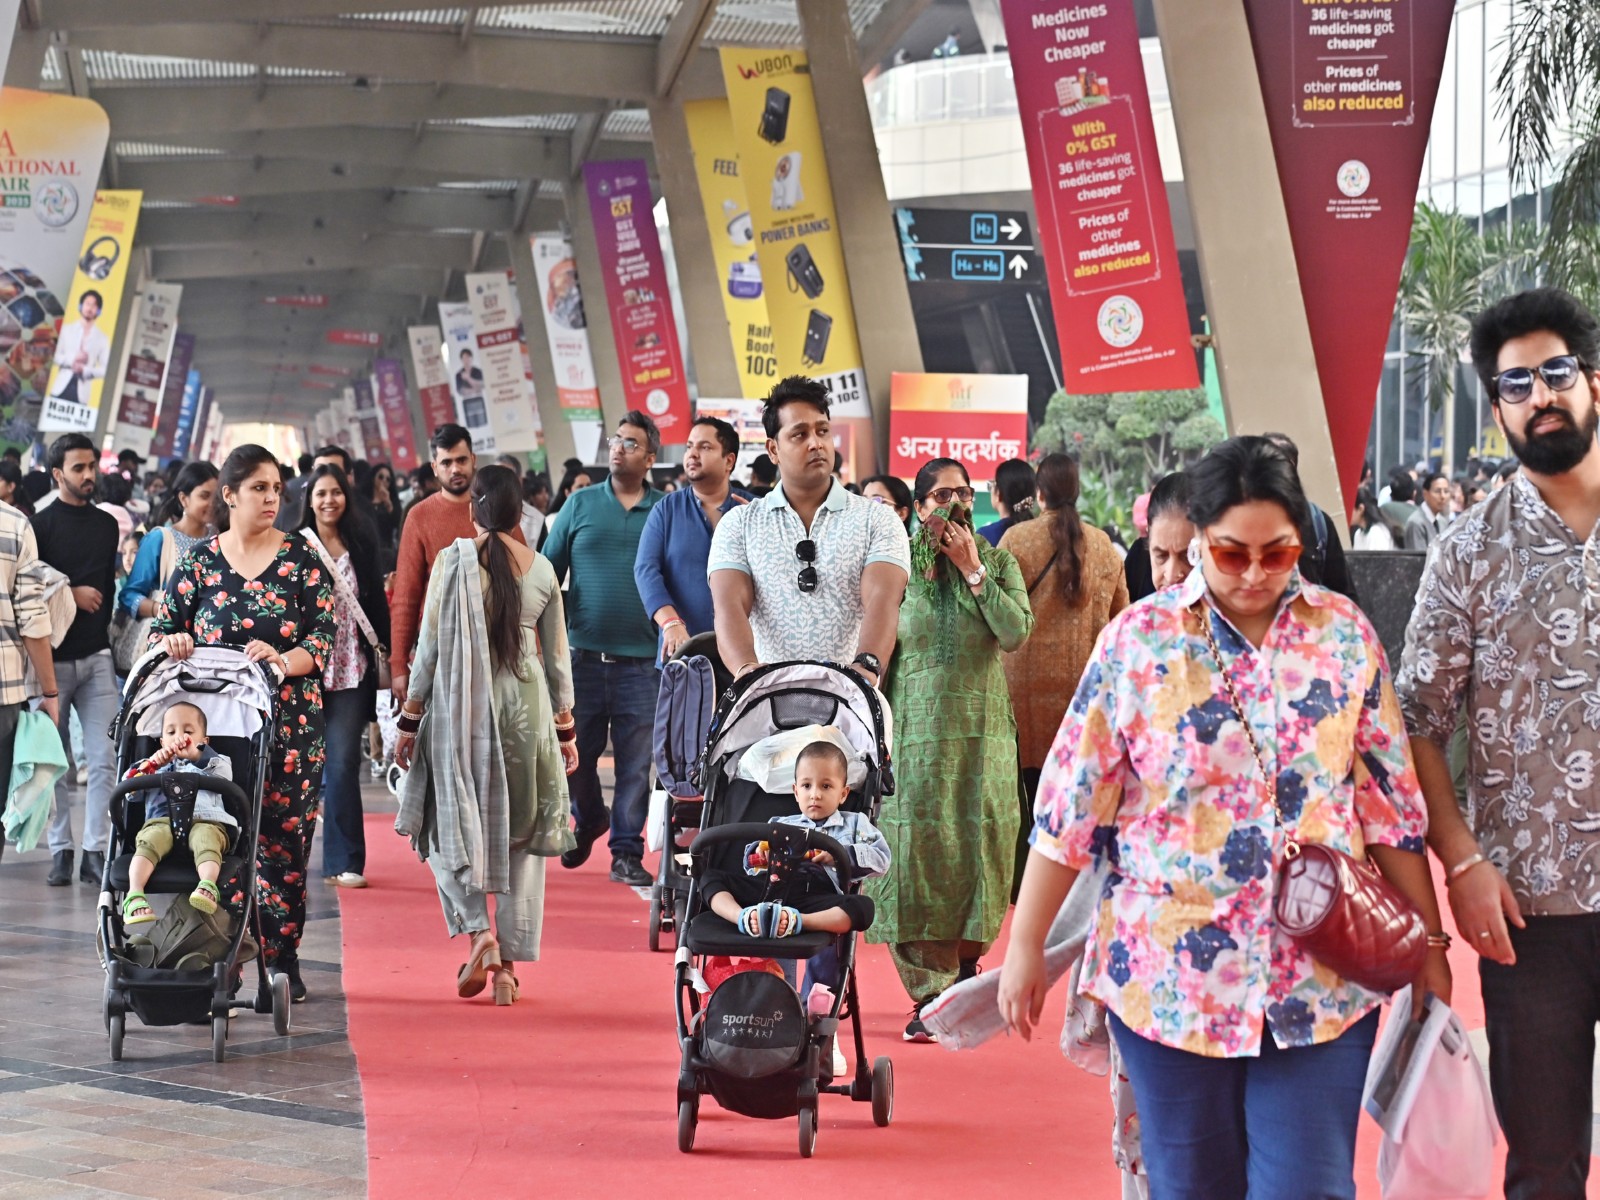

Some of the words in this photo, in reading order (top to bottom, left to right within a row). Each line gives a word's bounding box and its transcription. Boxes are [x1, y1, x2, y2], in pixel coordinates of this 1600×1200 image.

[1031, 4, 1107, 29] Medicines
[1311, 8, 1327, 21] 36
[1329, 6, 1392, 22] life-saving
[1055, 25, 1090, 43] Now
[1309, 22, 1371, 35] medicines
[1374, 22, 1395, 36] got
[1044, 40, 1106, 63] Cheaper
[1327, 37, 1377, 51] cheaper
[1326, 65, 1364, 78] Prices
[1365, 64, 1379, 77] of
[1304, 81, 1336, 93] other
[1339, 79, 1402, 92] medicines
[1303, 95, 1336, 111] also
[1339, 94, 1404, 111] reduced
[1072, 120, 1106, 138] With
[1066, 141, 1089, 156] 0%
[1091, 134, 1117, 151] GST
[713, 158, 739, 177] FEEL
[1058, 161, 1074, 175] 36
[1075, 152, 1132, 172] life-saving
[1059, 169, 1116, 190] medicines
[1117, 164, 1136, 181] got
[1077, 184, 1122, 203] cheaper
[1078, 214, 1116, 230] Prices
[1117, 208, 1130, 222] of
[760, 227, 796, 245] POWER
[797, 218, 831, 238] BANKS
[1091, 227, 1123, 243] other
[1079, 239, 1141, 261] medicines
[1074, 262, 1100, 278] also
[1101, 252, 1151, 273] reduced
[745, 355, 778, 378] 10C
[839, 372, 858, 390] 11
[837, 390, 861, 404] 10C
[48, 400, 75, 416] Hall
[79, 406, 92, 420] 11
[896, 435, 943, 460] अन्य
[946, 431, 1021, 463] प्रदर्शक
[722, 1013, 774, 1028] sportsun
